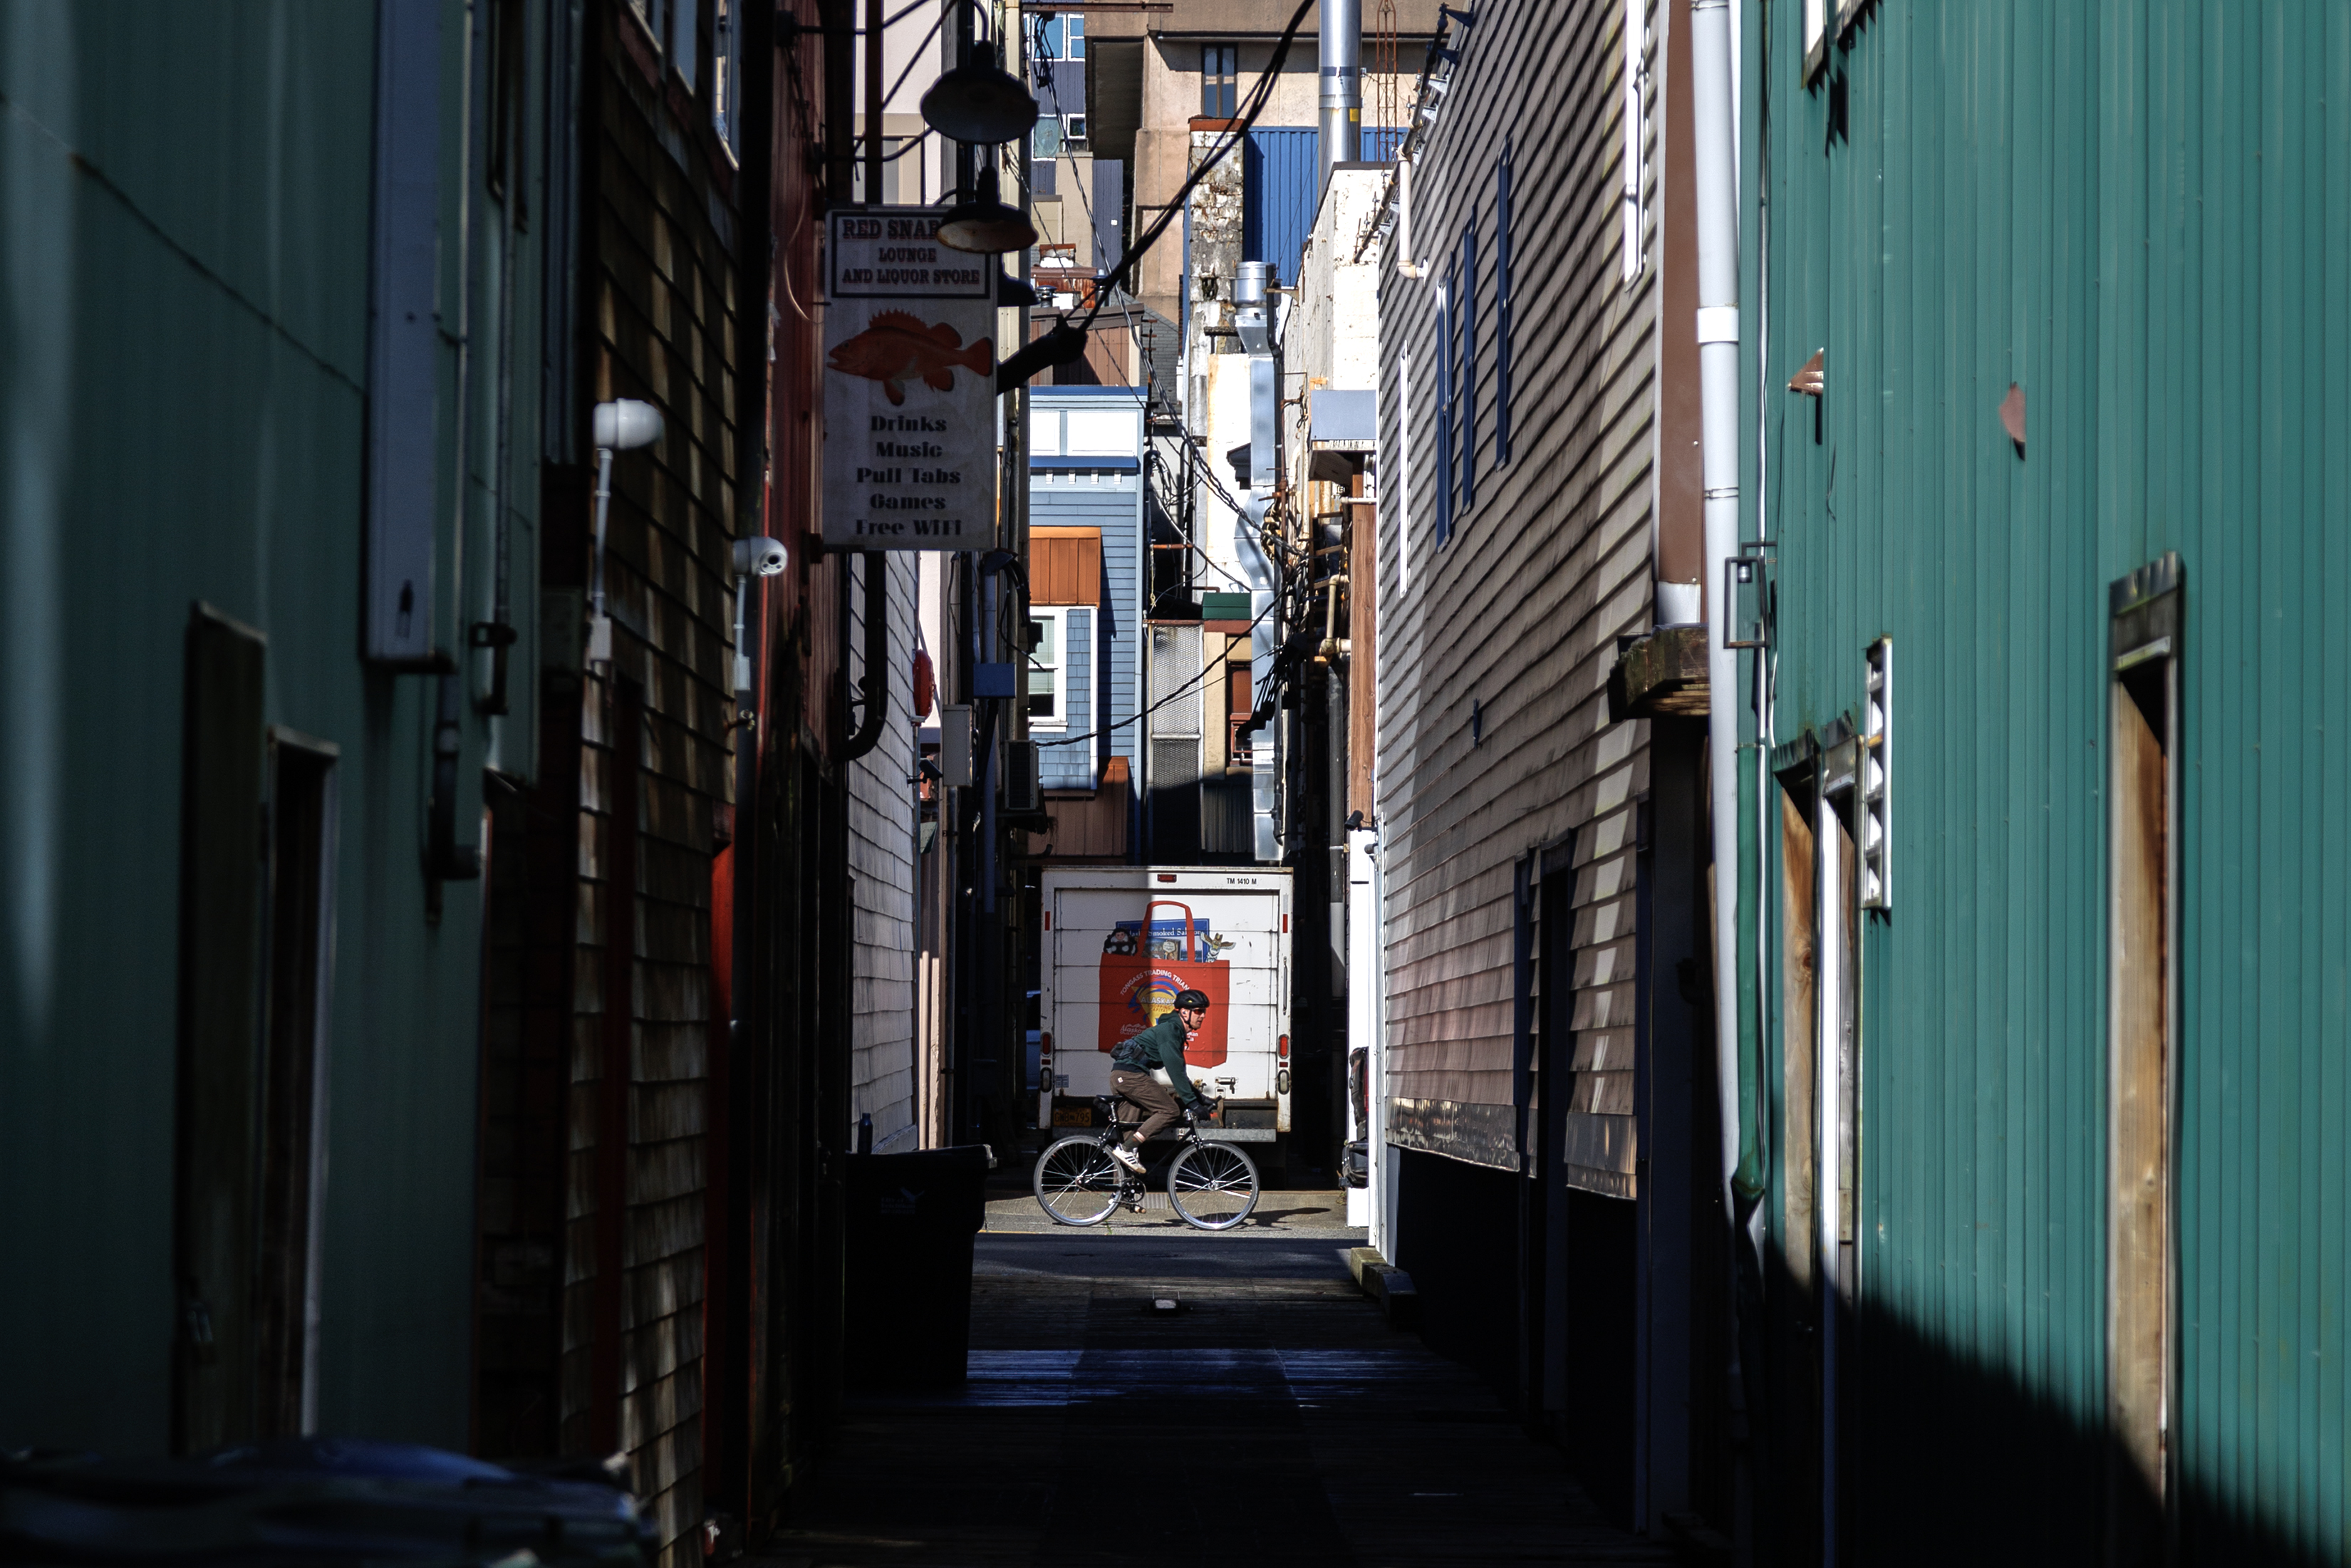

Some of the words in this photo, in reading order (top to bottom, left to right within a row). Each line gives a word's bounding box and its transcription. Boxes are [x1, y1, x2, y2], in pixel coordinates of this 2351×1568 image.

[843, 219, 882, 239] RED
[888, 219, 942, 239] SNAP
[878, 247, 937, 262] LOUNGE
[842, 269, 873, 284] AND
[877, 269, 929, 285] LIQUOR
[933, 269, 980, 284] STORE
[871, 415, 947, 431] Drinks
[876, 441, 943, 457] Music
[856, 467, 901, 483] Pull
[908, 467, 960, 484] Tabs
[870, 493, 946, 509] Games
[855, 519, 904, 534] Free
[913, 519, 961, 535] WiFi
[1148, 928, 1175, 937] Smoked
[1119, 972, 1144, 996] TONGASS
[1143, 969, 1172, 978] TRADING
[1172, 974, 1190, 991] TRIAN
